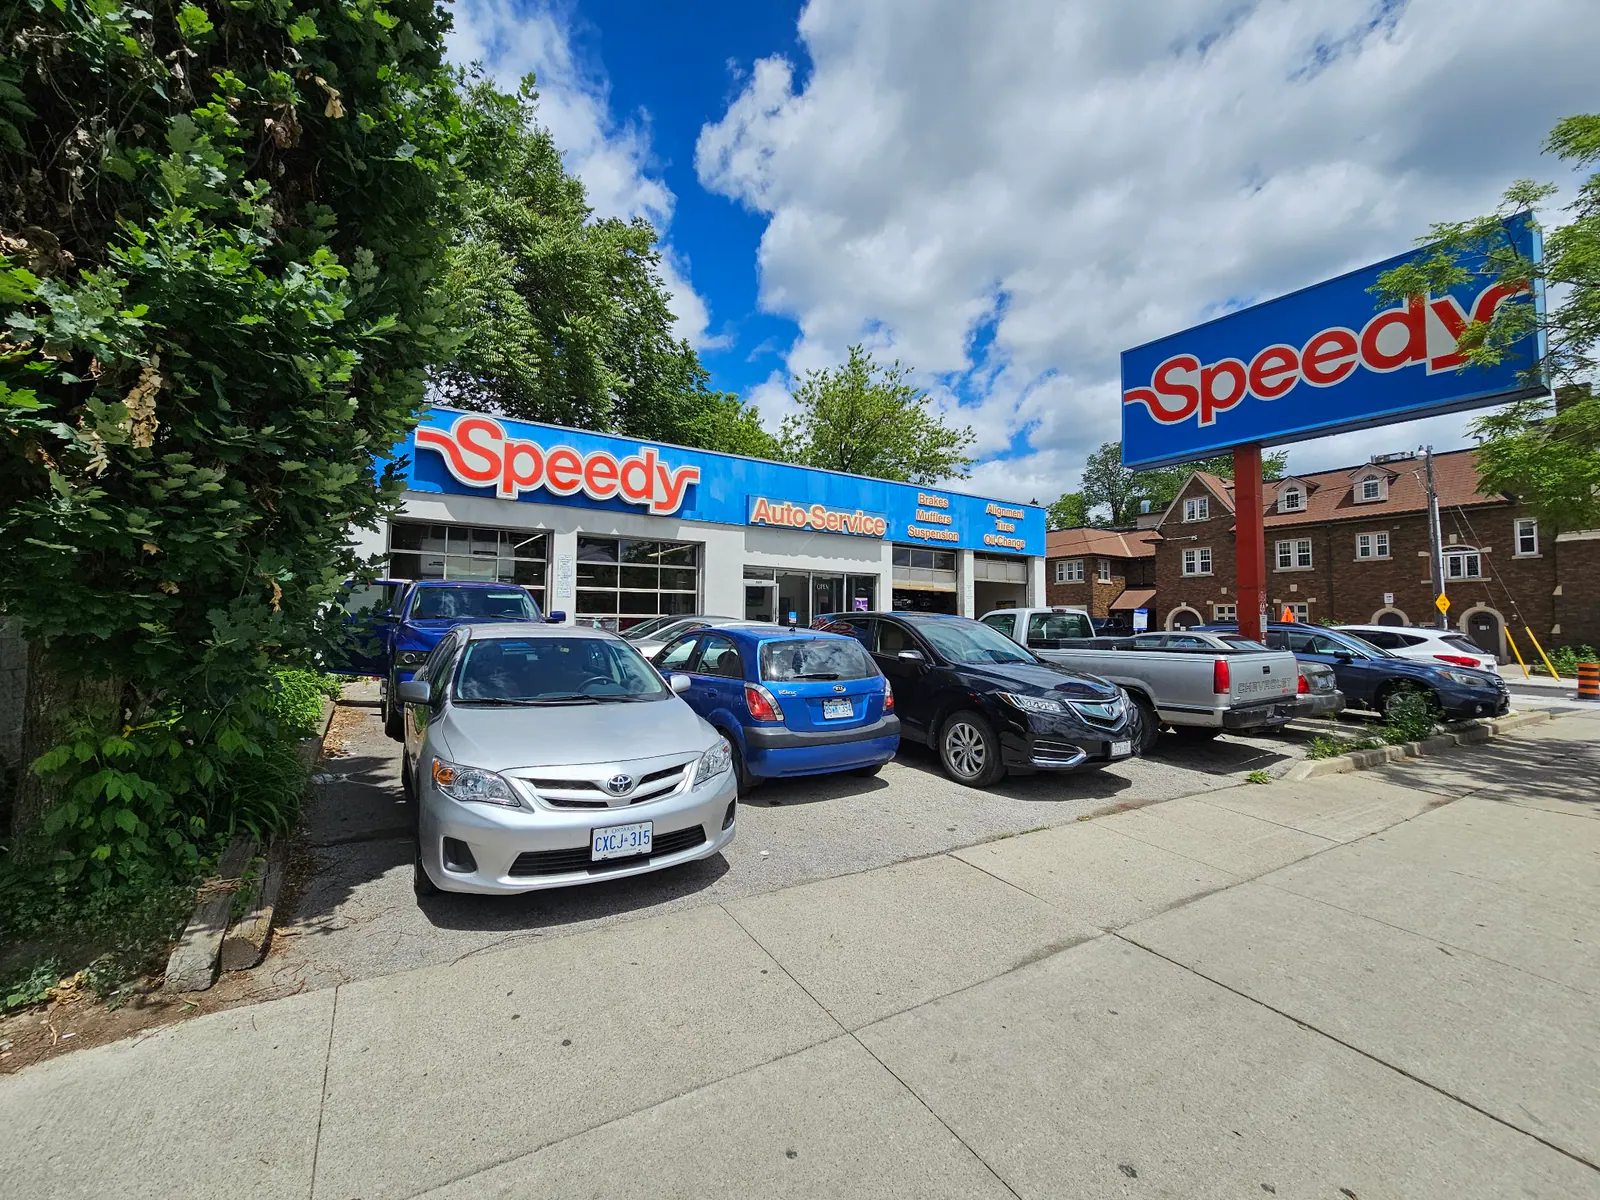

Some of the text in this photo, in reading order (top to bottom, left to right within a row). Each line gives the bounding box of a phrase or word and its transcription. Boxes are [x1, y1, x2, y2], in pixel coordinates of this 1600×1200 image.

[1124, 281, 1530, 425] Speedy
[416, 417, 700, 513] Speedy
[918, 493, 948, 507] Brakes
[752, 498, 886, 535] Auto Service
[916, 509, 951, 524] Mufflers
[986, 504, 1024, 519] Alignment
[908, 525, 959, 541] Suspension
[996, 520, 1015, 532] Tires
[984, 534, 1025, 550] Oil Change
[595, 830, 650, 852] CXCJ 315
